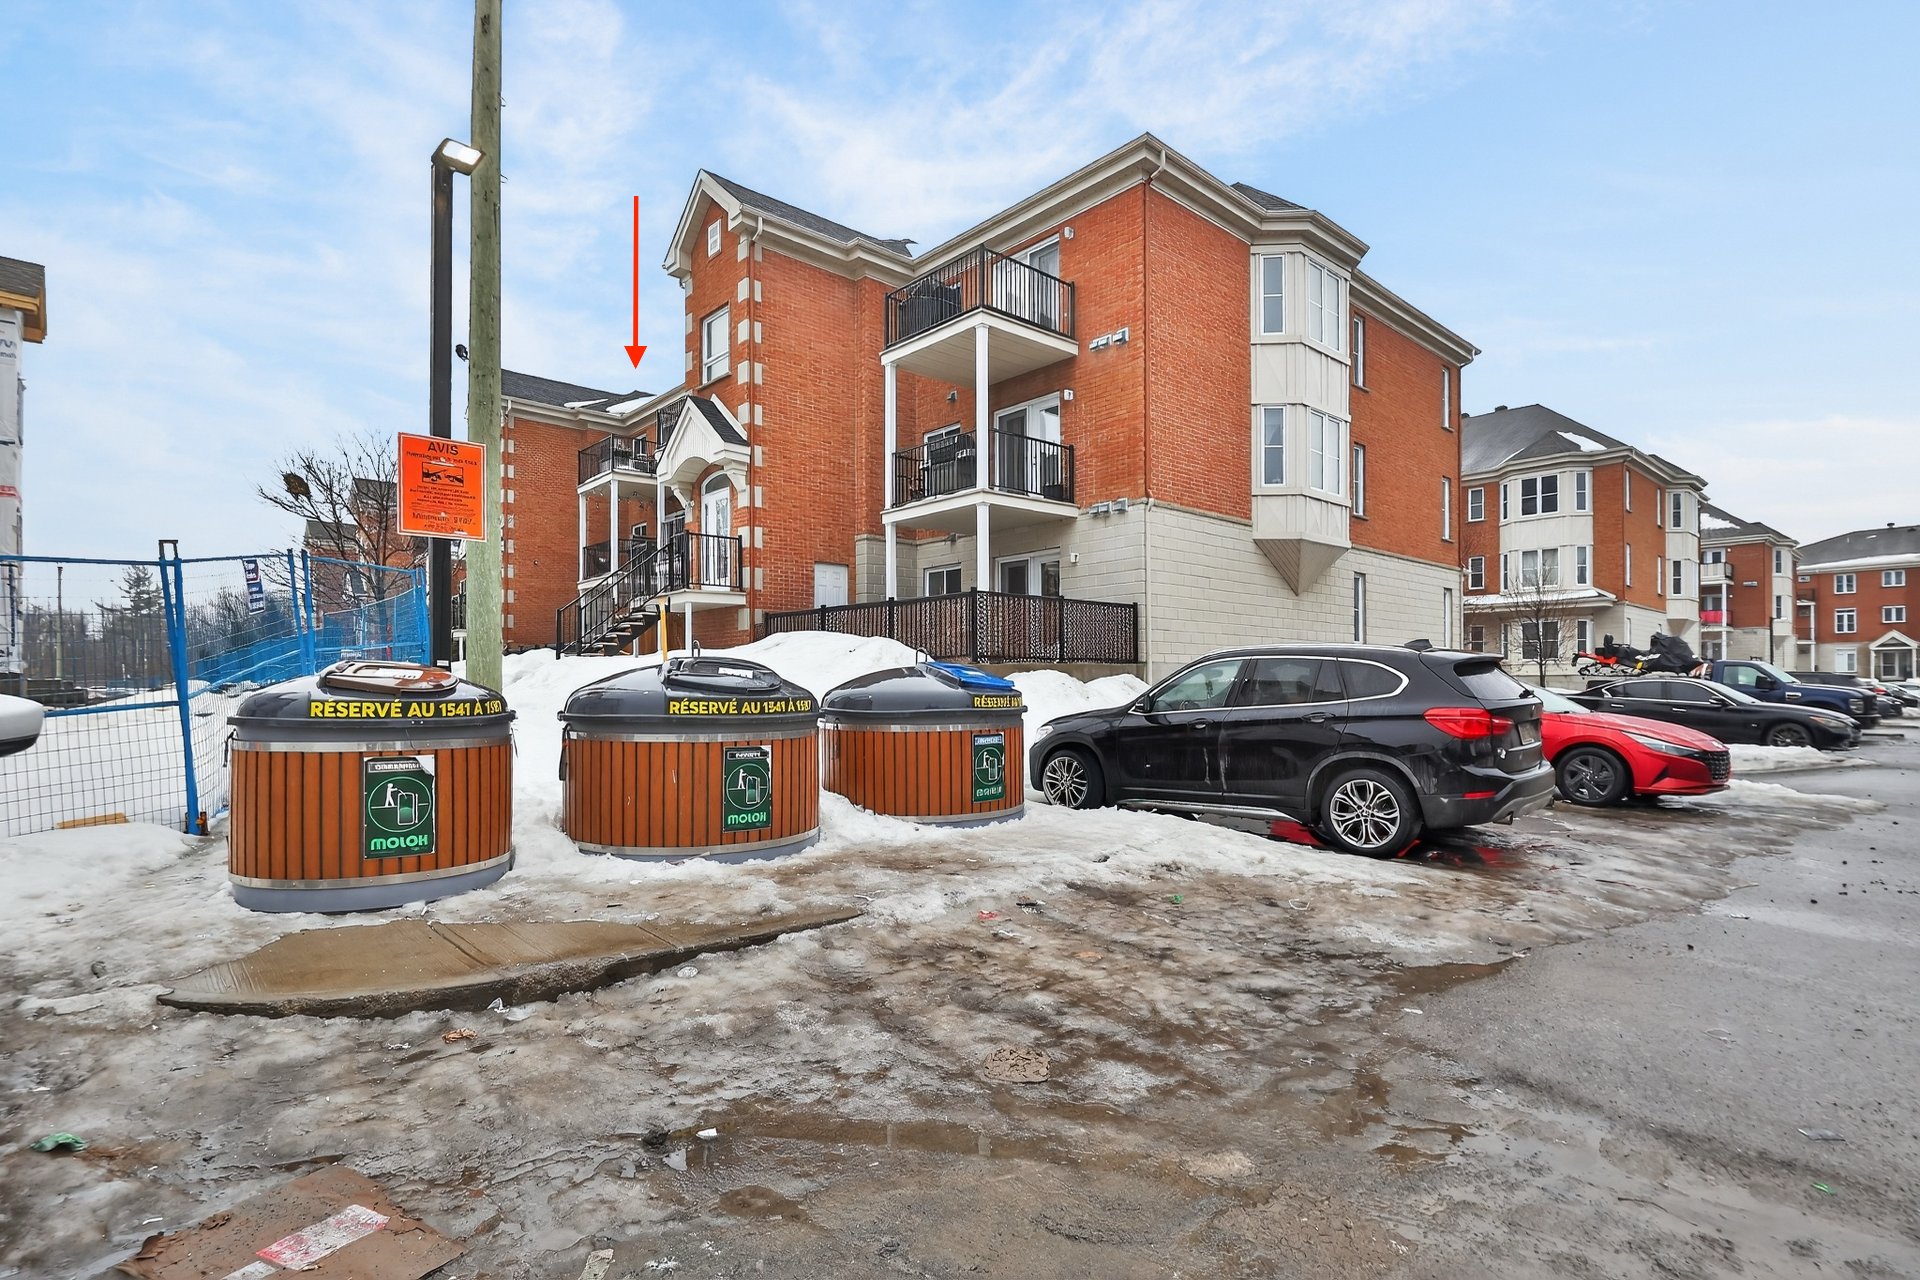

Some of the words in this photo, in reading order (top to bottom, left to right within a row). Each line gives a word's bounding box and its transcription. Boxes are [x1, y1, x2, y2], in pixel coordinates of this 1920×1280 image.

[428, 441, 459, 455] AVIS
[310, 698, 403, 718] RÉSERVÉ
[407, 701, 435, 718] AU
[438, 701, 471, 717] 1541
[473, 698, 483, 716] À
[669, 697, 738, 715] RÉSERVÉ
[741, 701, 760, 715] AU
[763, 699, 786, 713] 1541
[787, 697, 796, 712] À
[370, 834, 429, 851] MOLOK
